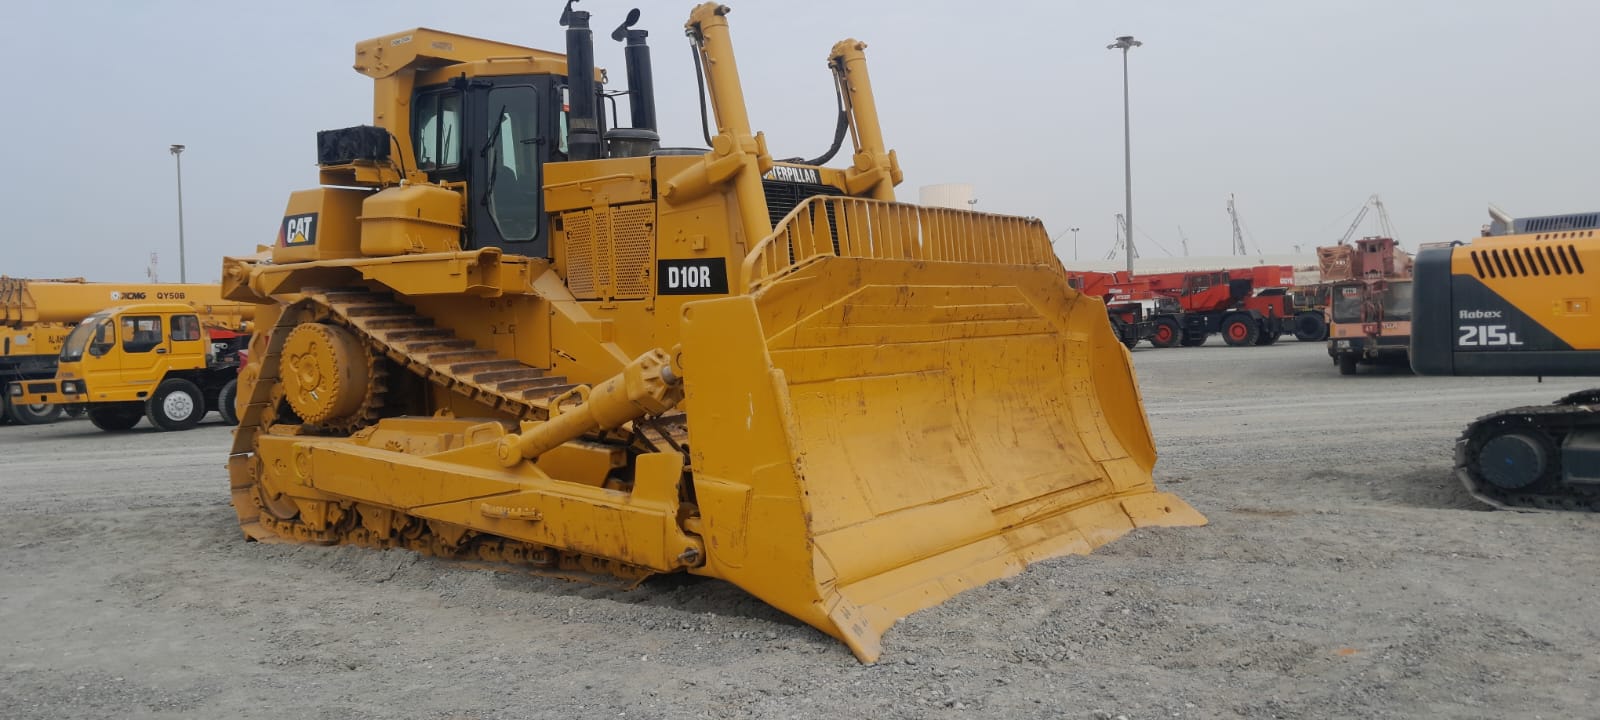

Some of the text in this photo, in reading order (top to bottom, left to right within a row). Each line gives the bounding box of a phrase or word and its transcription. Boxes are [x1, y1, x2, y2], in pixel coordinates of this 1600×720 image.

[287, 216, 313, 243] CAT
[668, 266, 711, 288] D10R
[156, 292, 186, 300] QY50B
